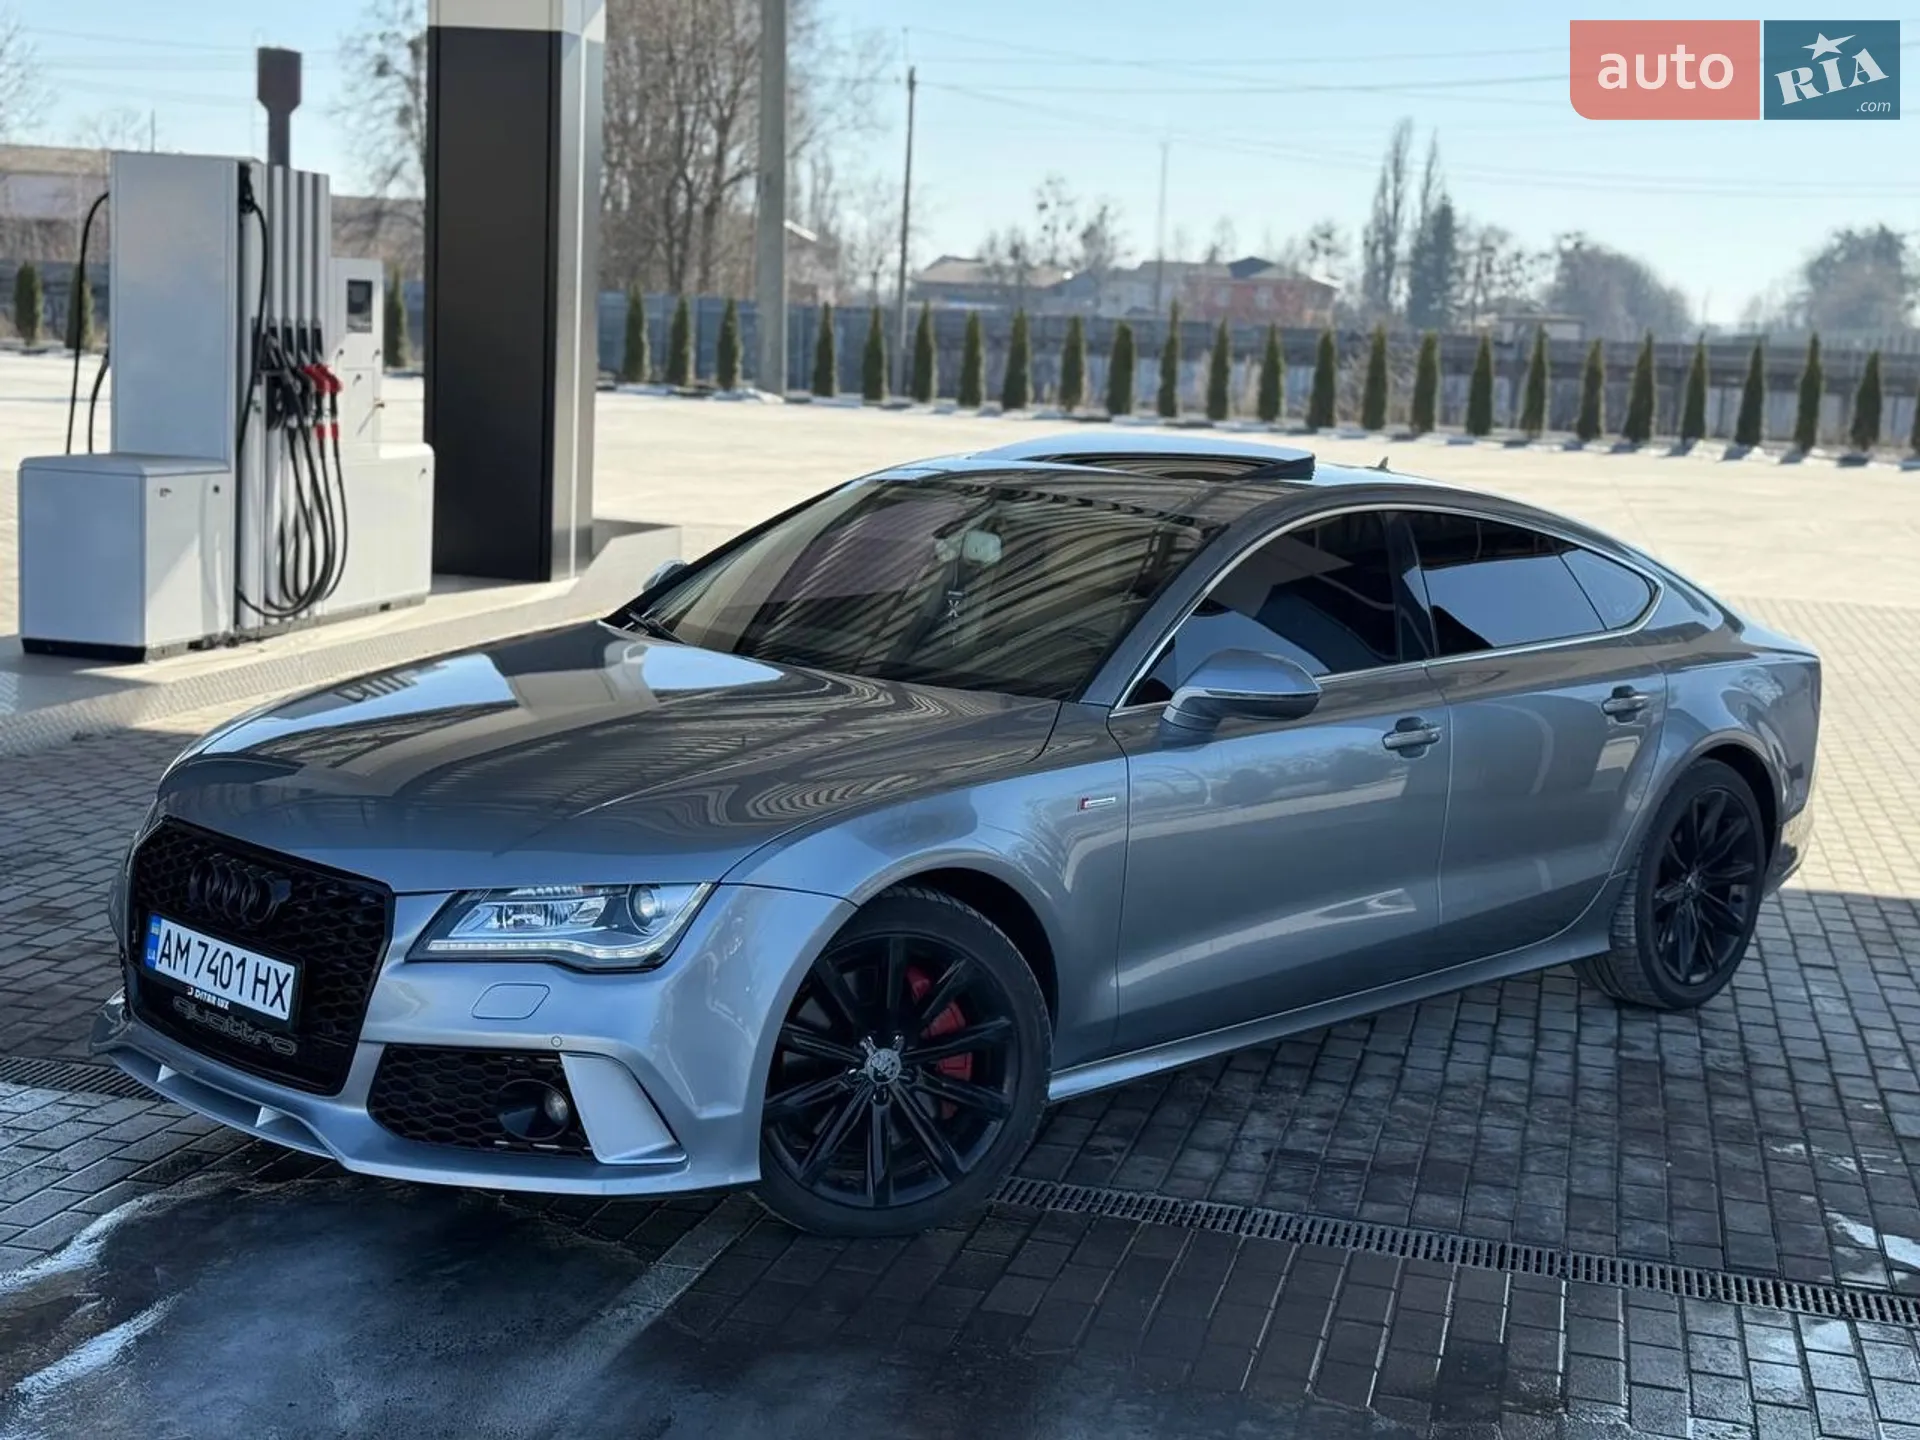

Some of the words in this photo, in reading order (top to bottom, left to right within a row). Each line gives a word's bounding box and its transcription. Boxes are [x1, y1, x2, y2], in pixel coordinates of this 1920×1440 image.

[158, 928, 192, 976] AM
[194, 940, 248, 997] 7401
[252, 961, 291, 1012] HX
[172, 995, 298, 1056] quattro
